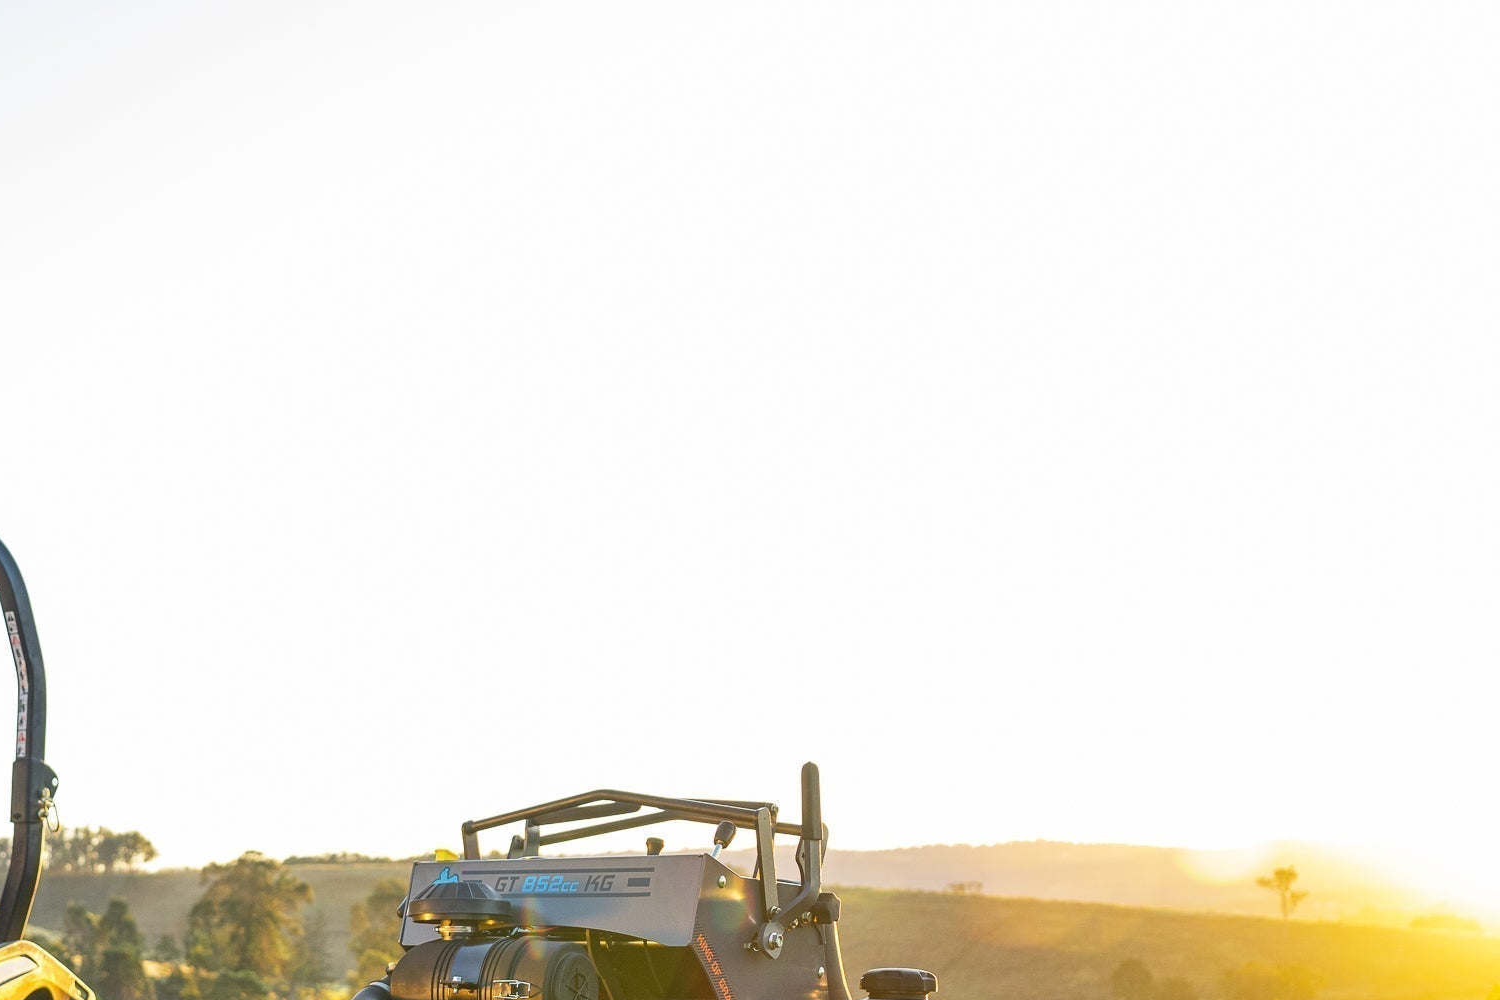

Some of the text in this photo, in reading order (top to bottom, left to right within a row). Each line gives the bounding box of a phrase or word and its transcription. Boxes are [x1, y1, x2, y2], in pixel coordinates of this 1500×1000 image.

[494, 874, 616, 893] GT 852cc KG
[697, 933, 714, 962] KING
[711, 960, 722, 975] OF
